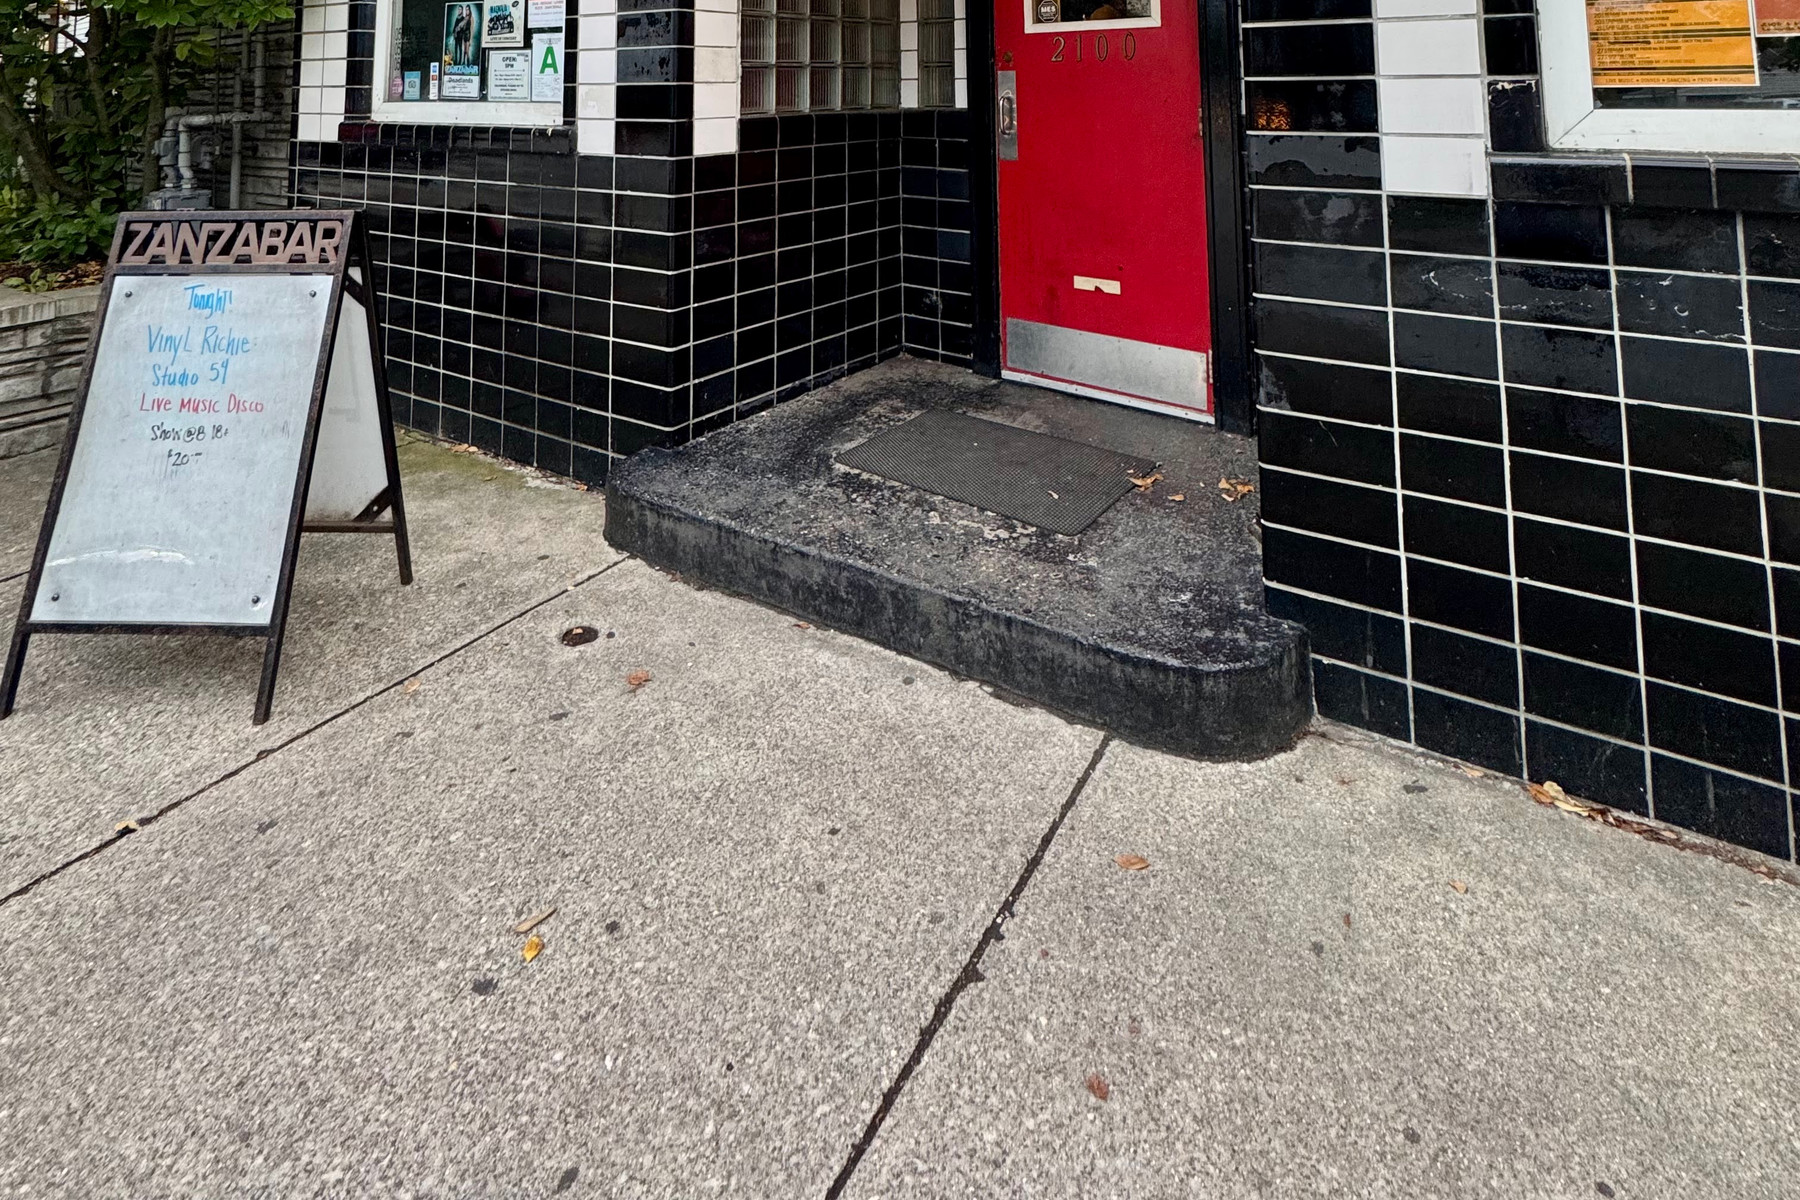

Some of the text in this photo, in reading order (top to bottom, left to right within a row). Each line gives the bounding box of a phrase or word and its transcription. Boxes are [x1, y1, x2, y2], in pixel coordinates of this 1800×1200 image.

[539, 46, 559, 74] A
[1051, 31, 1136, 62] 2100
[120, 221, 343, 265] ZANZABAR
[152, 358, 230, 387] Studio 54
